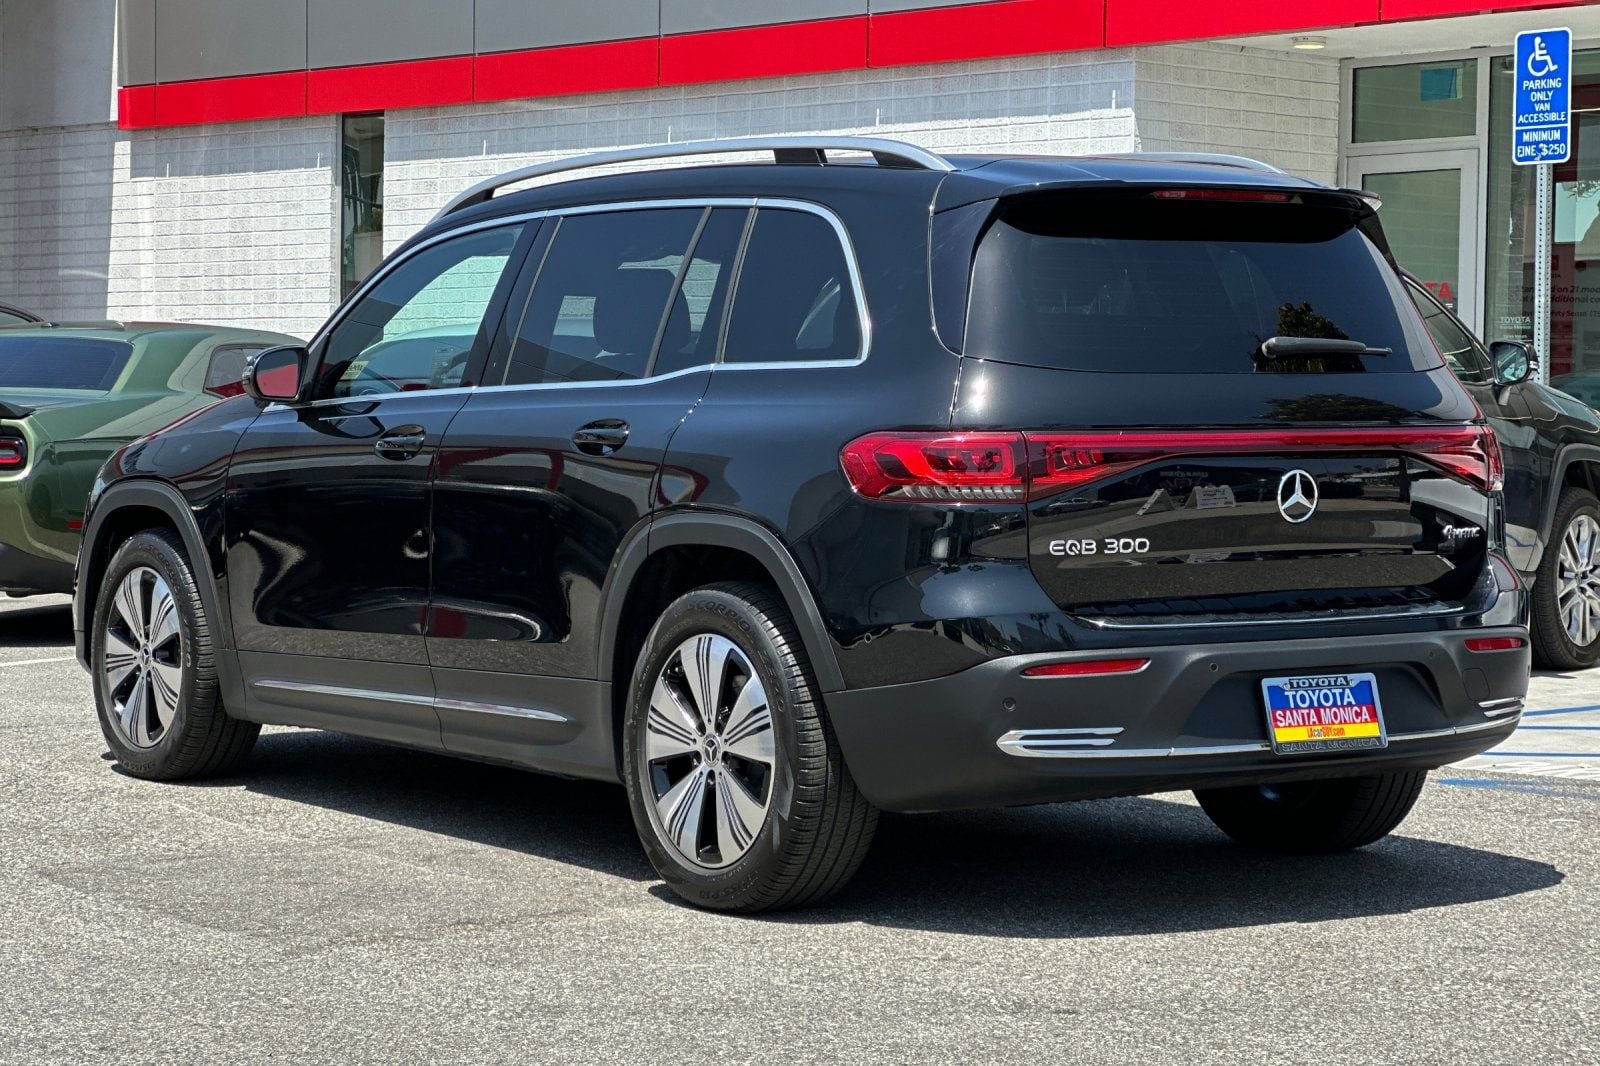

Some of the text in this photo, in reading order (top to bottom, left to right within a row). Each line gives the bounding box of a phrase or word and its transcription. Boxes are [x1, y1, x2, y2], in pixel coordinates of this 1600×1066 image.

[1523, 78, 1562, 91] PARKING
[1530, 90, 1554, 102] ONLY
[1534, 102, 1551, 112] VAN
[1517, 112, 1567, 124] ACCESSIBLE
[1522, 129, 1561, 142] MINIMUM
[1517, 143, 1566, 157] FINE $250
[1500, 316, 1531, 324] TOYOTA
[1049, 538, 1150, 556] EQB 300
[1289, 677, 1348, 689] TOYOTA
[1284, 688, 1357, 709] TOYOTA
[1275, 706, 1372, 728] SANTA MONICA
[1281, 738, 1380, 753] SANTA MONICA
